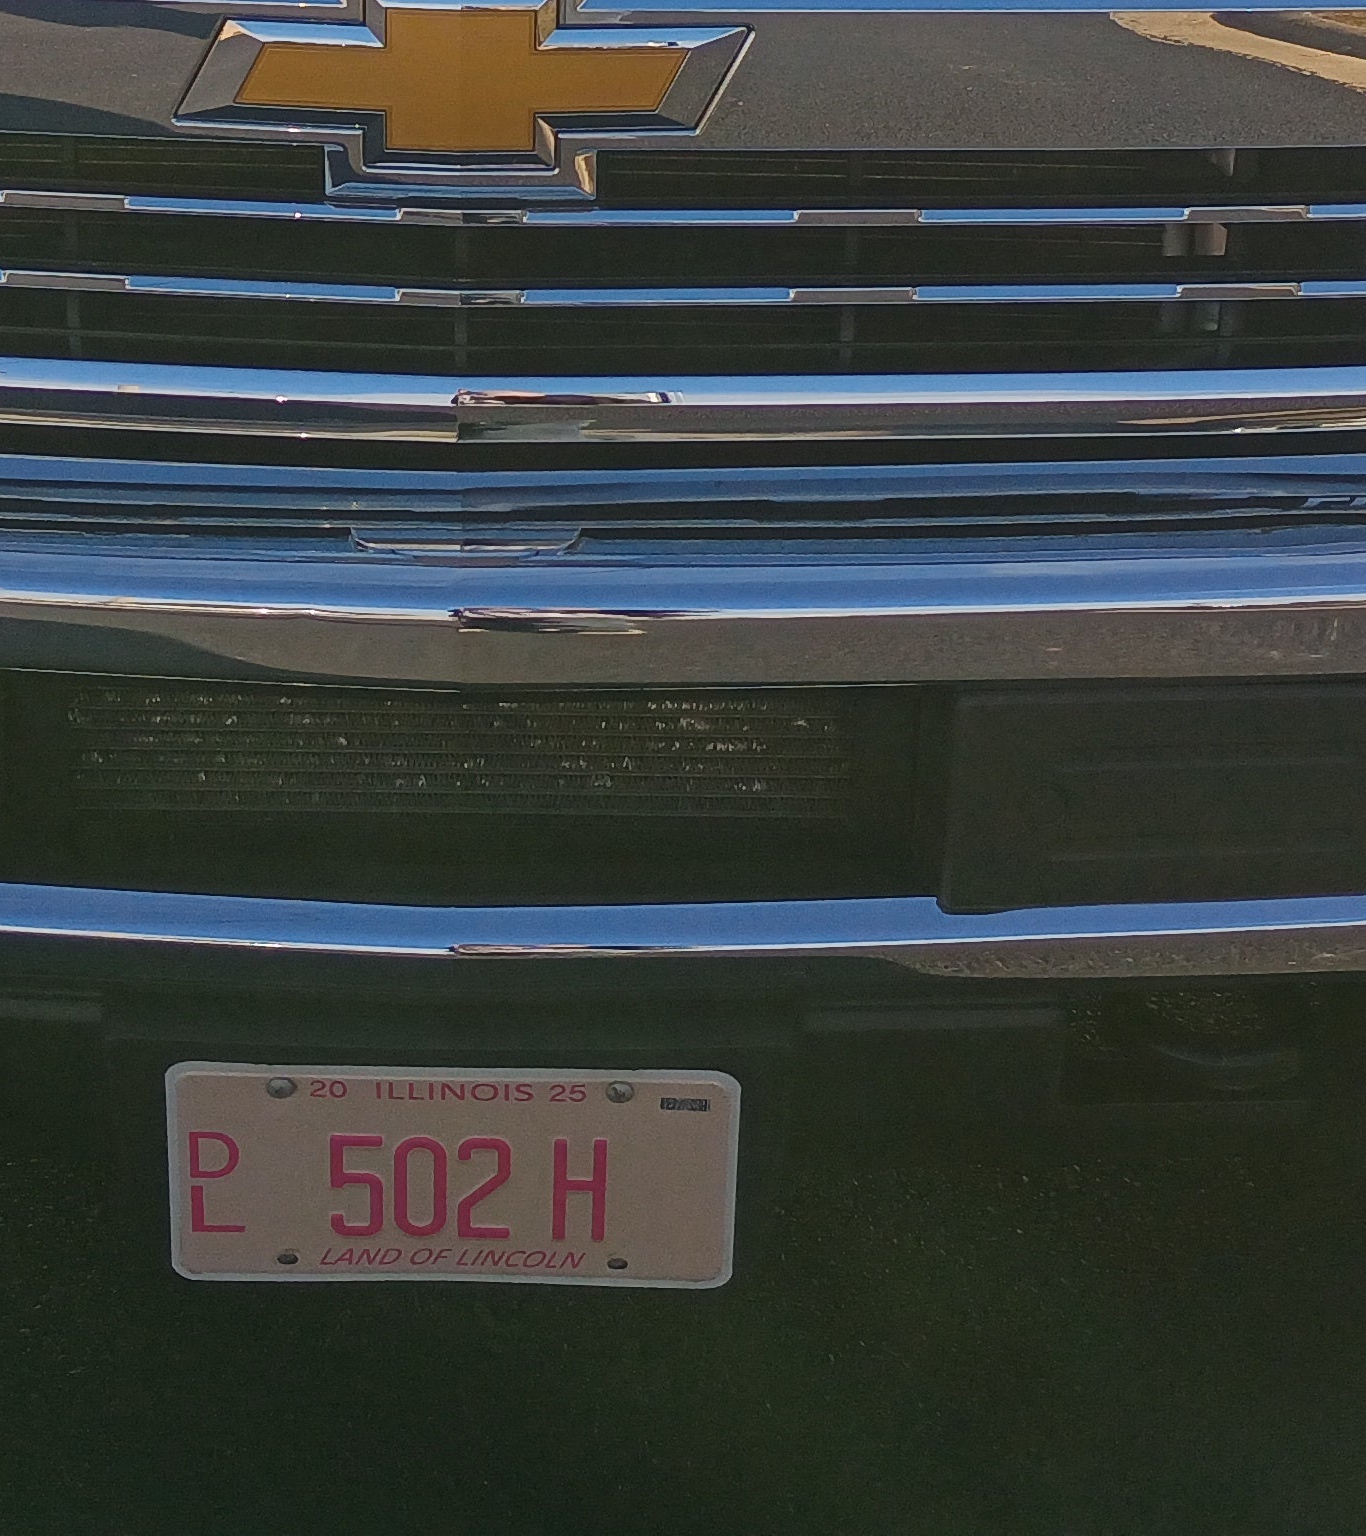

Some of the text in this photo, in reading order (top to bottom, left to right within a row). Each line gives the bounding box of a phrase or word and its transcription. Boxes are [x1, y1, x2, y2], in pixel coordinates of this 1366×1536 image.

[309, 1079, 587, 1103] 20 ILLINOIS 25
[329, 1134, 608, 1242] 502 H
[319, 1247, 587, 1269] LAND OF LINCOLN
